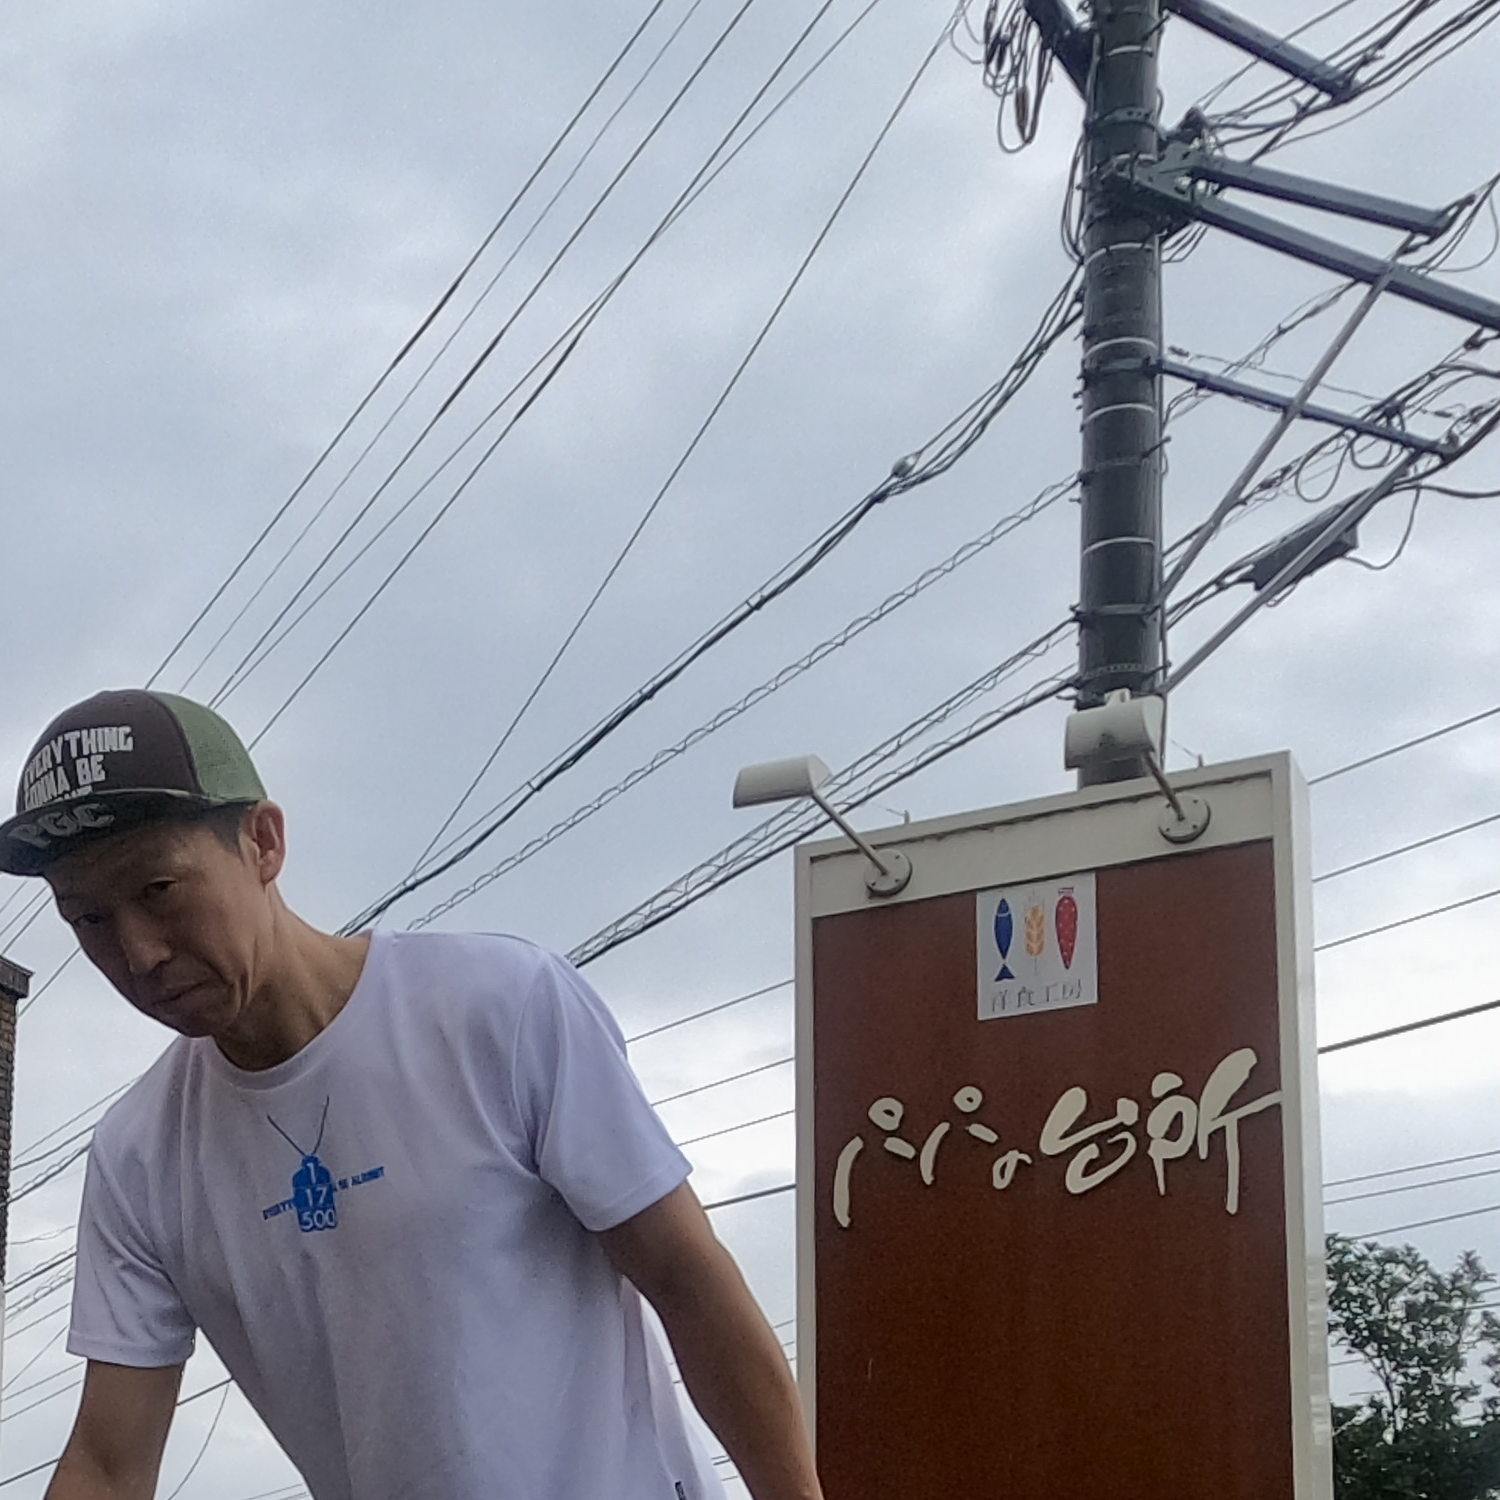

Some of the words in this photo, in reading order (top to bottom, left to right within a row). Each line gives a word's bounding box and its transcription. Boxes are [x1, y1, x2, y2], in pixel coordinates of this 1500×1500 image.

[25, 726, 134, 795] EVERYTHING
[76, 754, 106, 786] BE
[305, 1187, 327, 1206] 17
[301, 1209, 336, 1229] 500
